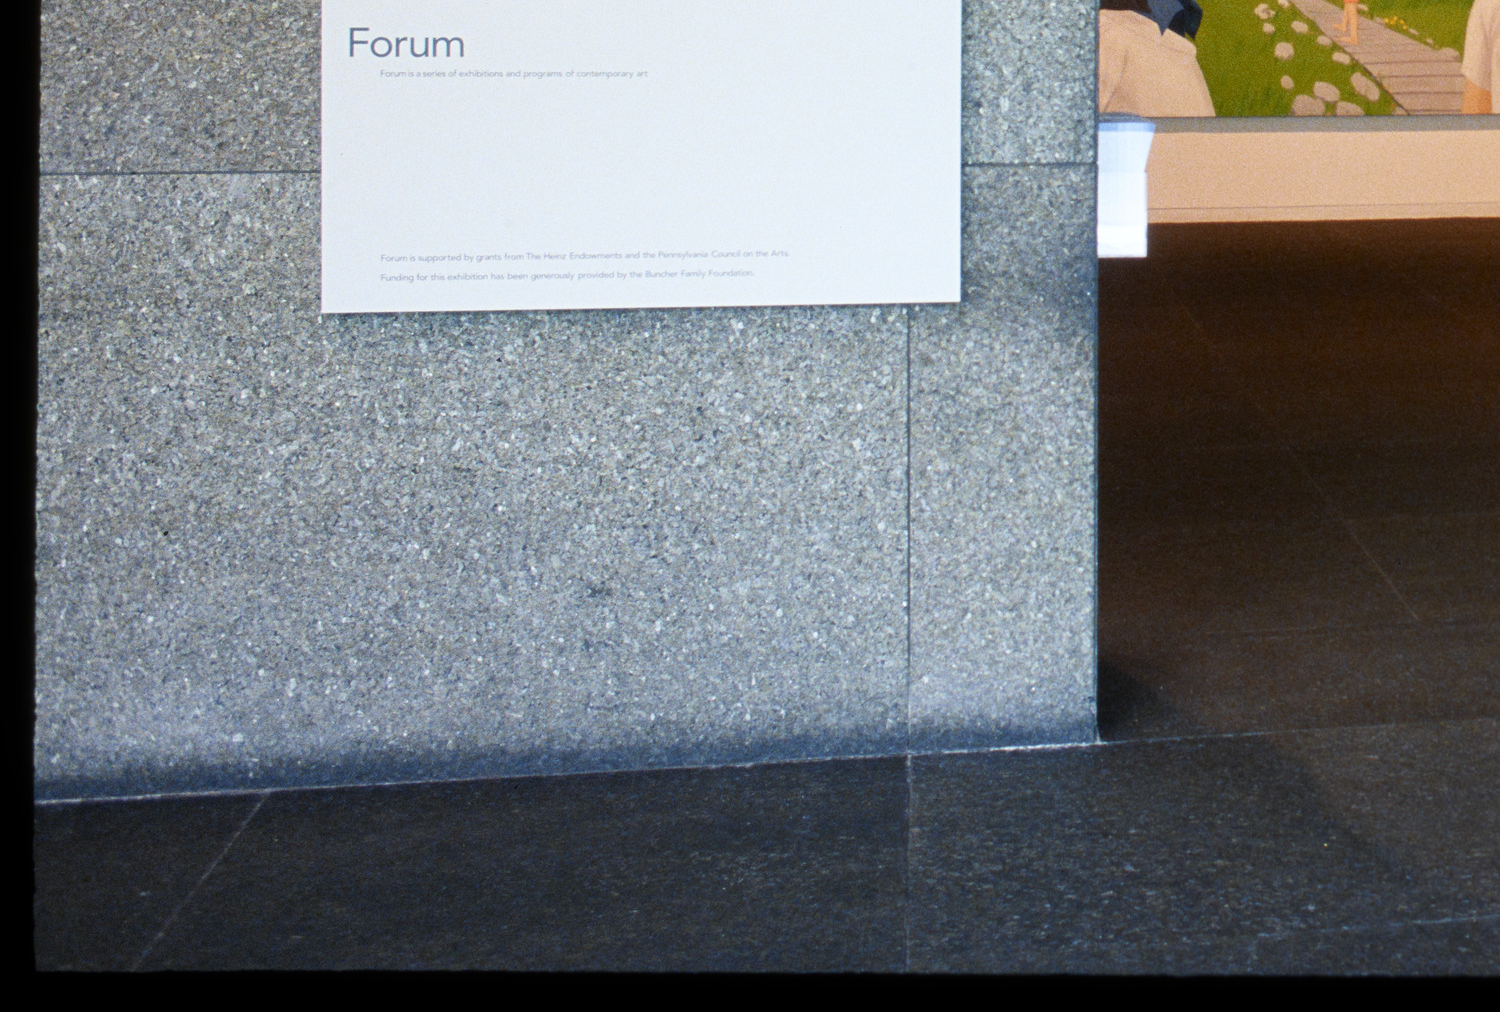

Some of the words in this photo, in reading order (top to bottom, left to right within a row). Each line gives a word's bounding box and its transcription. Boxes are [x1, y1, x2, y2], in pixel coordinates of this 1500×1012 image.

[349, 27, 465, 58] Forum
[380, 69, 407, 78] Forum
[408, 70, 415, 78] is
[422, 70, 447, 78] series
[448, 69, 457, 78] of
[458, 69, 504, 78] exhibitions
[505, 69, 521, 78] and
[523, 70, 563, 80] programs
[565, 69, 575, 78] of
[576, 70, 634, 80] contemporary
[636, 70, 649, 78] art
[380, 254, 408, 262] Forum
[409, 254, 416, 262] is
[418, 253, 461, 263] supported
[463, 253, 475, 263] by
[475, 253, 502, 263] grants
[504, 252, 524, 261] from
[526, 252, 542, 260] The
[543, 252, 567, 260] Heinz
[569, 251, 623, 260] Endowments
[625, 251, 641, 259] and
[642, 251, 656, 259] the
[658, 250, 709, 260] Pennsylvania
[711, 249, 741, 258] Council
[743, 250, 754, 258] on
[755, 249, 769, 258] the
[380, 273, 415, 283] Funding
[416, 272, 429, 281] for
[430, 272, 446, 281] this
[446, 272, 489, 281] exhibition
[490, 272, 505, 281] has
[506, 271, 530, 280] been
[530, 271, 575, 281] generously
[577, 270, 615, 280] provided
[616, 270, 627, 279] by
[629, 270, 643, 278] the
[645, 270, 678, 278] Buncher
[680, 269, 706, 279] Family
